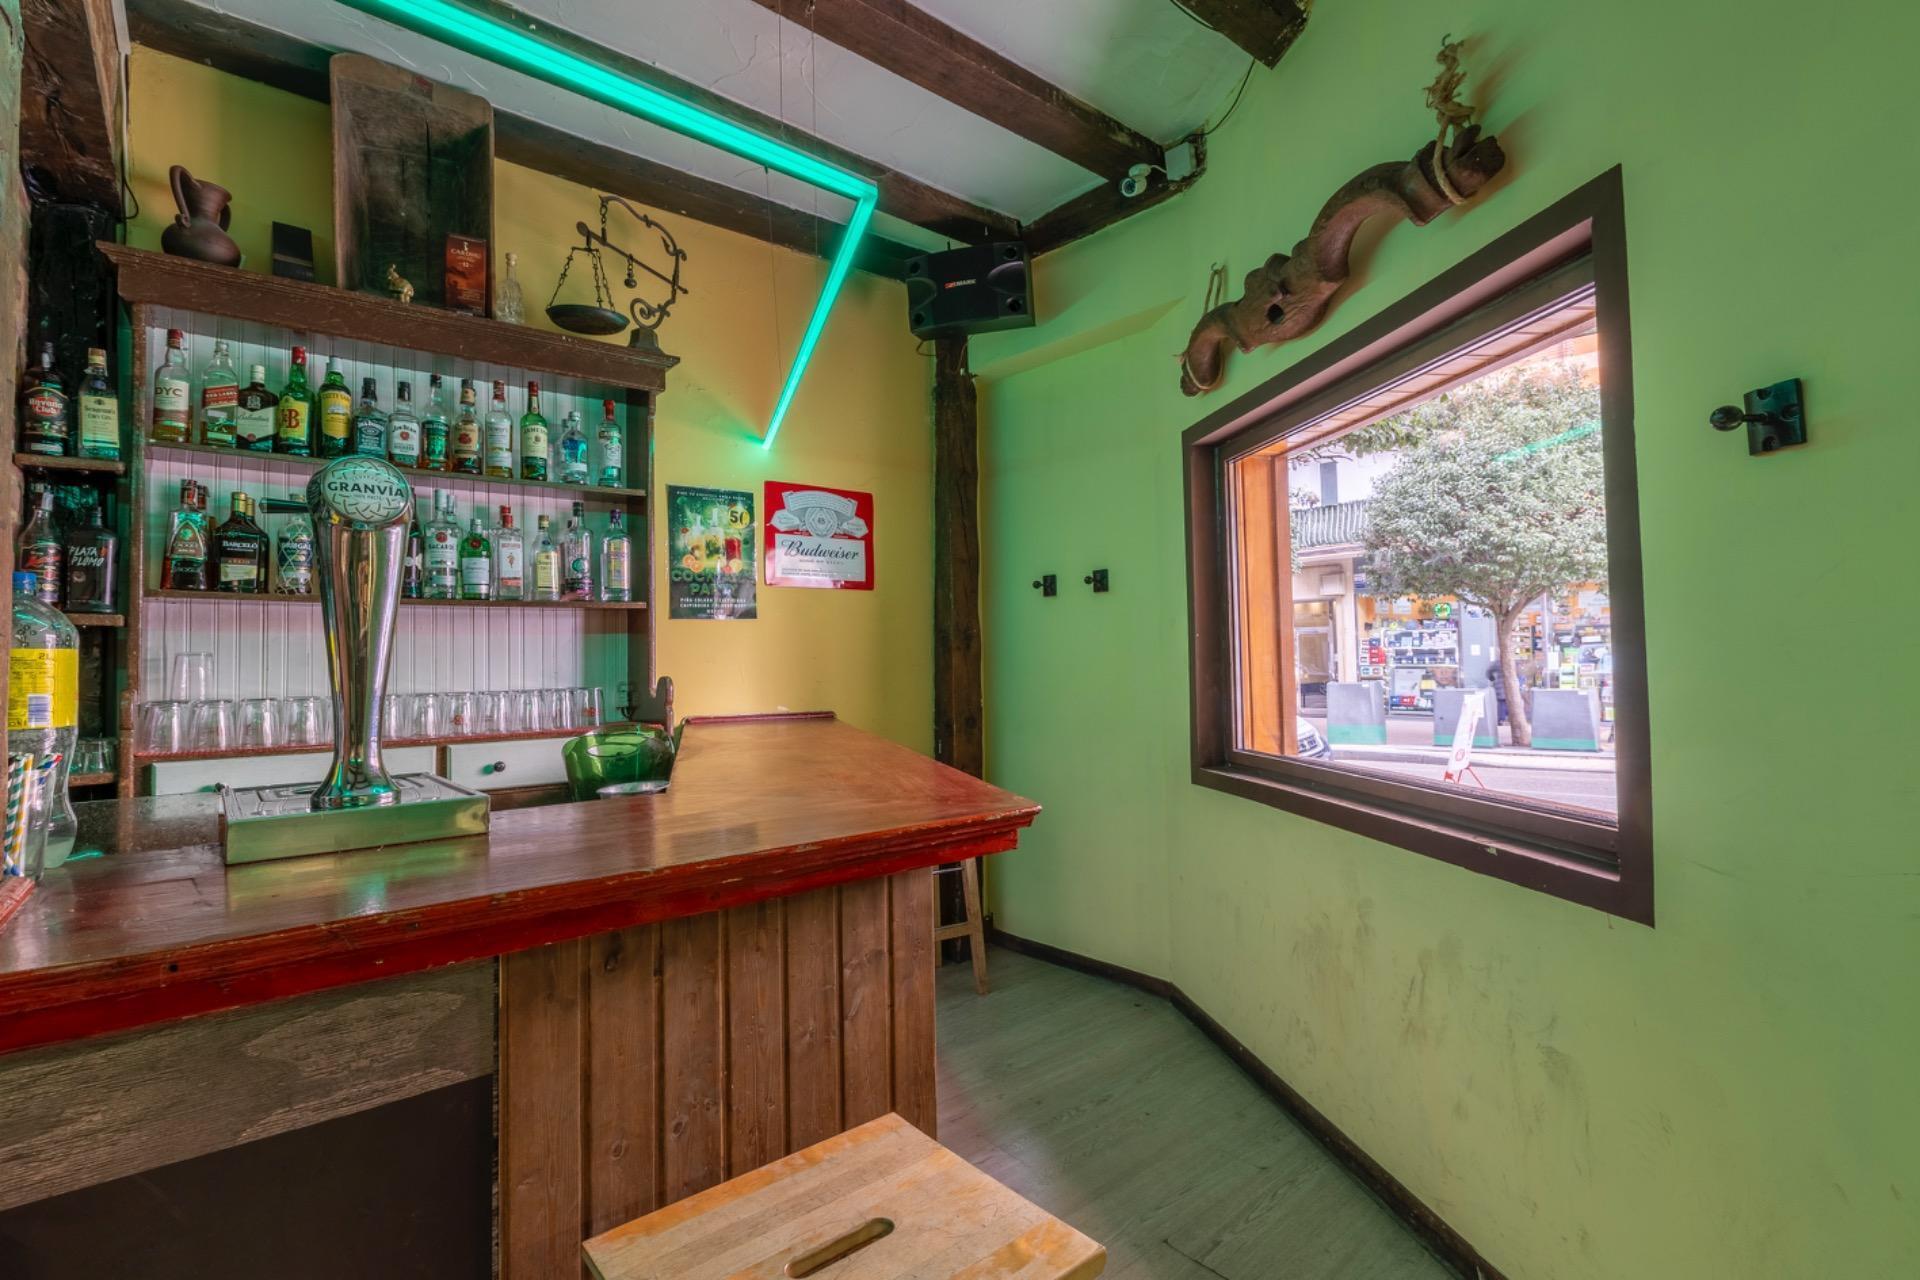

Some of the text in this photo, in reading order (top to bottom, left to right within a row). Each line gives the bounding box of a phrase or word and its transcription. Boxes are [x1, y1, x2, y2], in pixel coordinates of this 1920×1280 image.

[154, 386, 183, 397] DYC
[29, 398, 63, 409] Havana
[36, 406, 57, 414] Club
[42, 421, 51, 430] 7
[69, 546, 98, 557] PLATA
[781, 540, 859, 560] Budweiser
[71, 556, 105, 567] PLOMO
